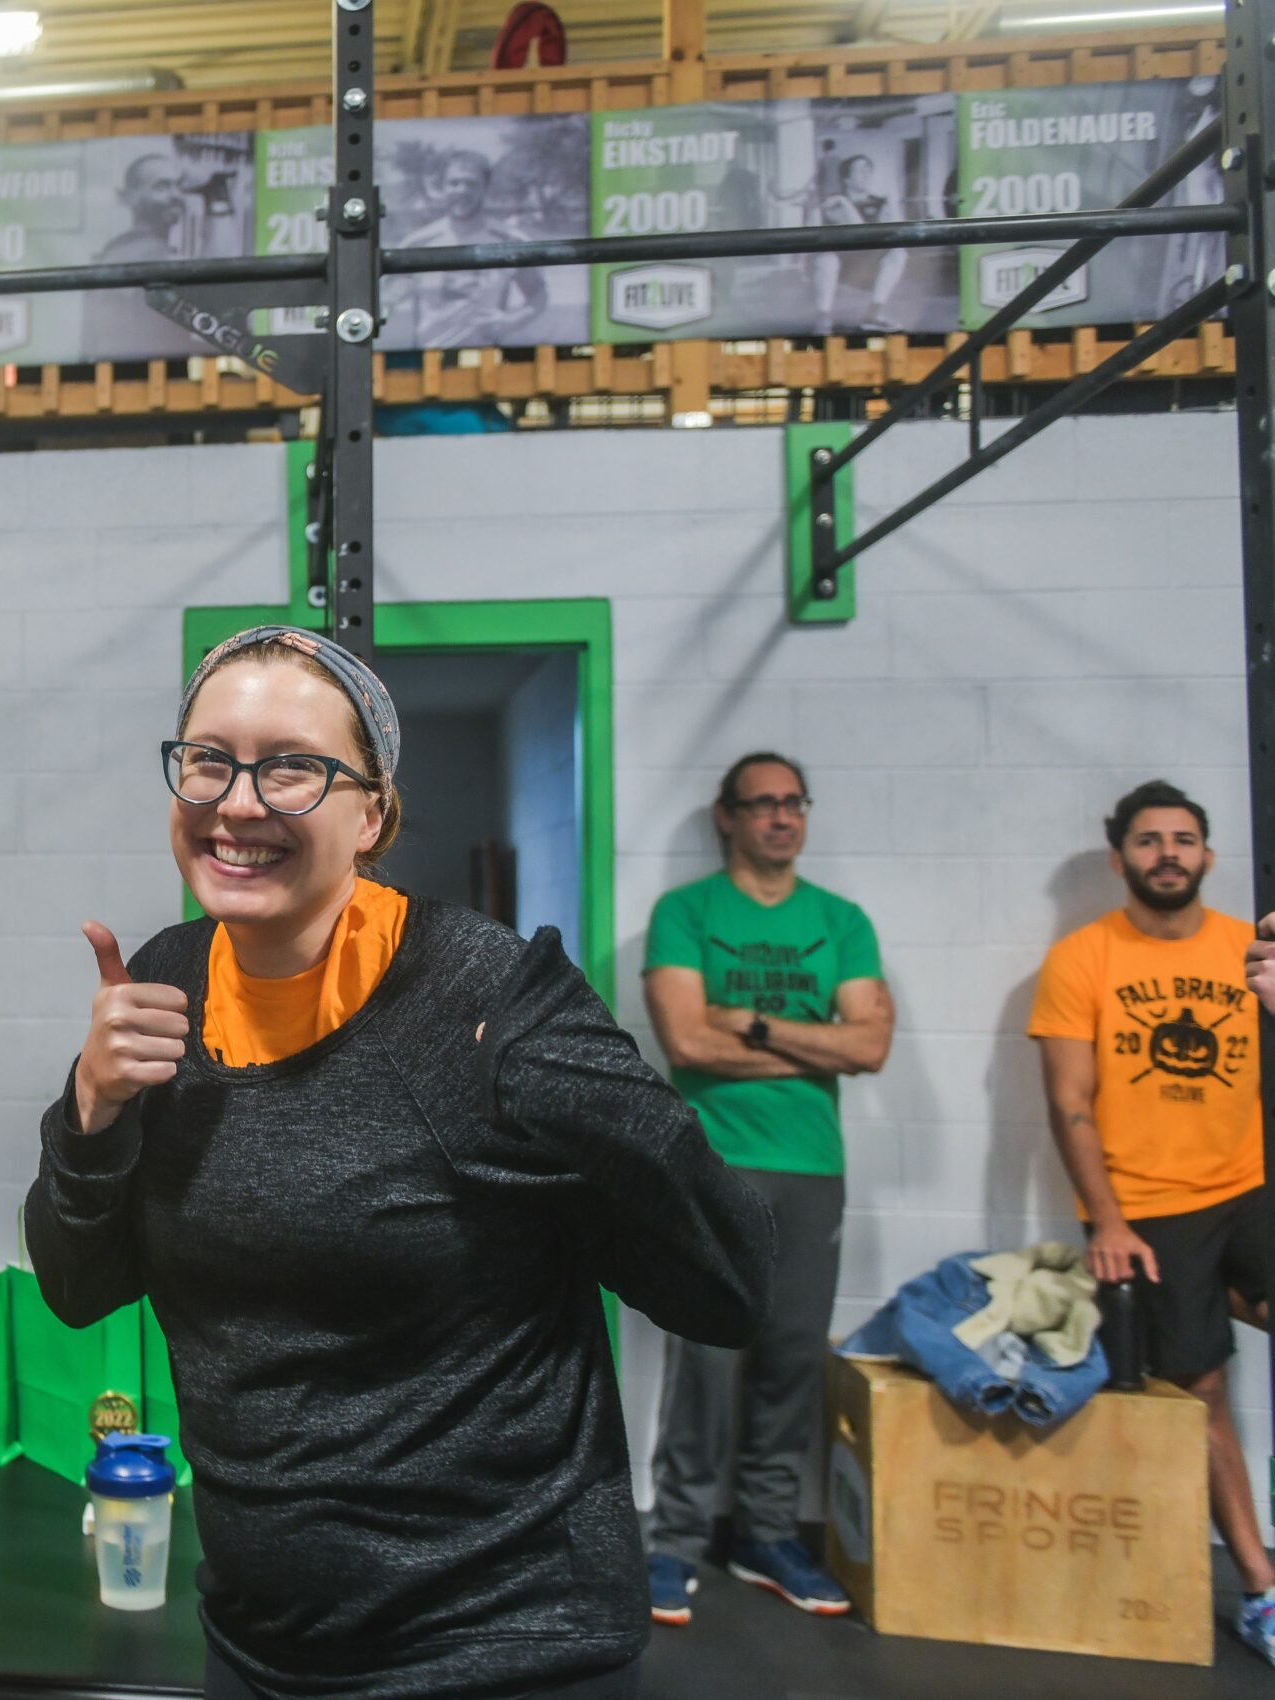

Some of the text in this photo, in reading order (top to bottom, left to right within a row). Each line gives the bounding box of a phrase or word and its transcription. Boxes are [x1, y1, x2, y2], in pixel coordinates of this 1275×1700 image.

[970, 101, 1007, 118] Eric
[970, 111, 1156, 149] FOLDENAUER
[602, 131, 739, 169] EIKSTADT
[266, 156, 337, 188] ERNS
[603, 190, 709, 234] 2000
[972, 172, 1081, 215] 2000
[266, 211, 328, 253] 20
[625, 279, 695, 309] FIT2LIVE
[1115, 977, 1247, 1013] FALL BRAWL
[1114, 1032, 1141, 1055] 20
[1226, 1035, 1249, 1059] 22
[95, 1409, 133, 1428] 2022
[933, 1481, 1142, 1531] FRINGE
[934, 1517, 1141, 1560] SPORT
